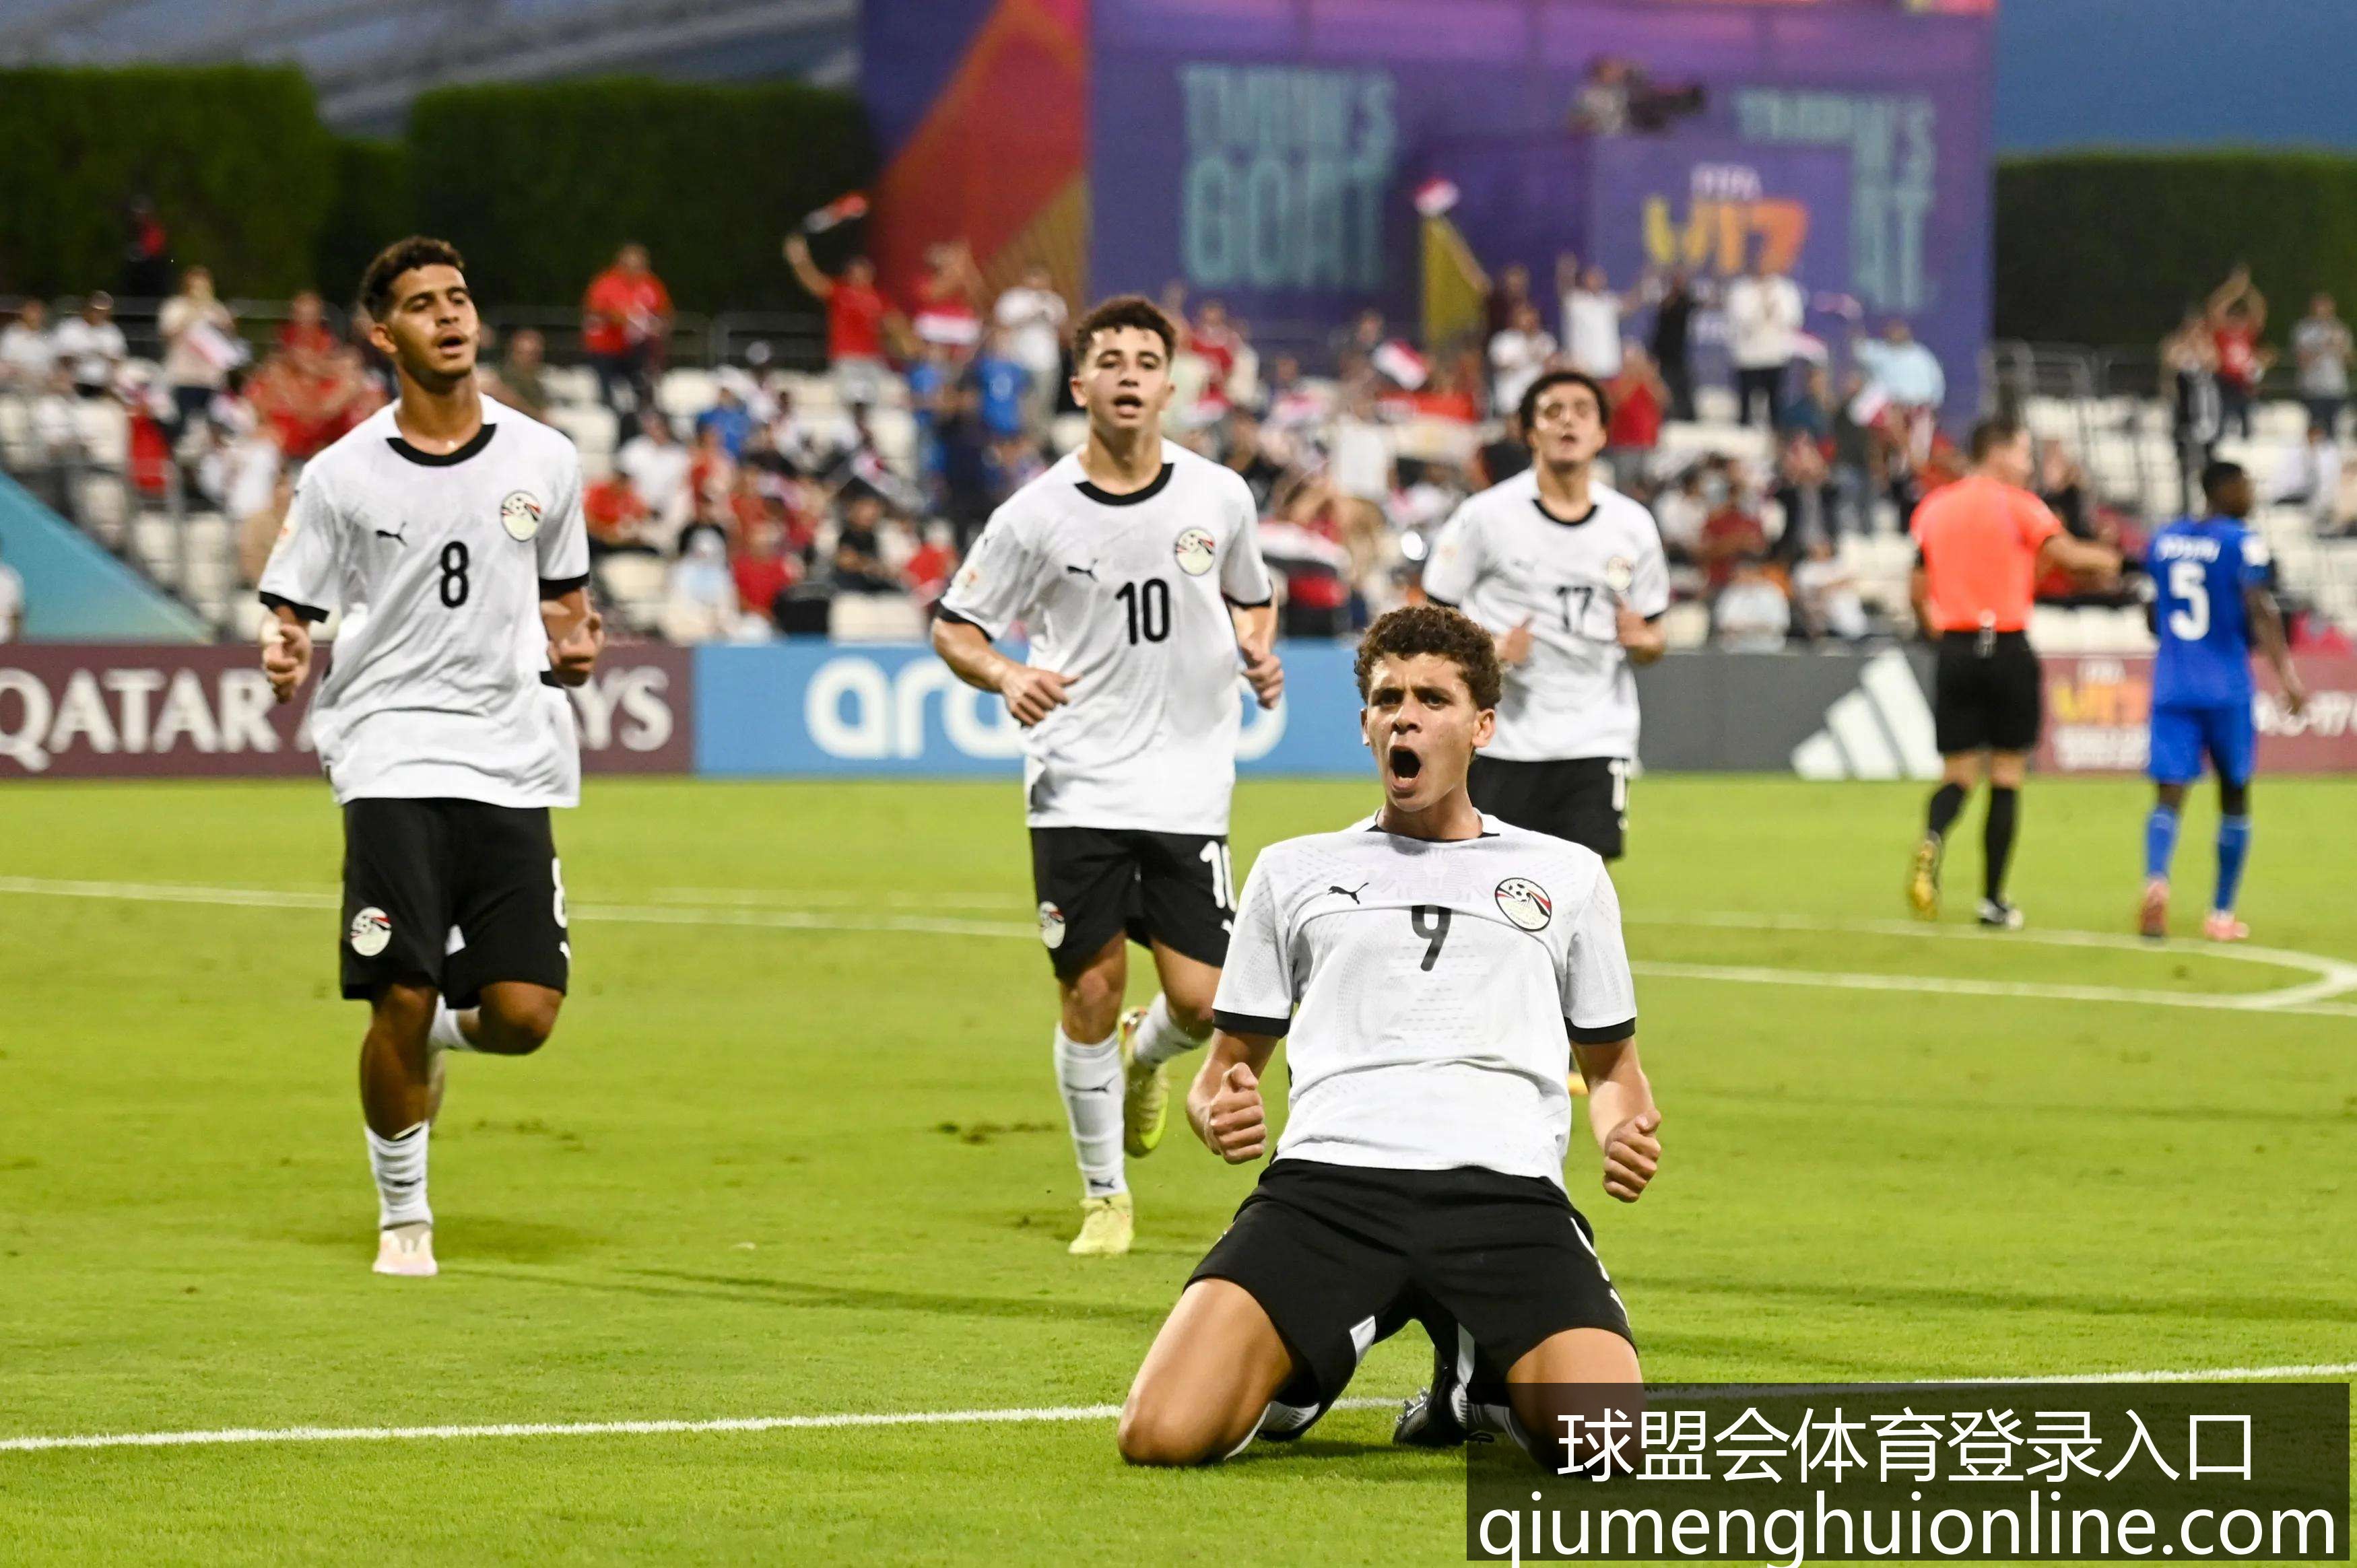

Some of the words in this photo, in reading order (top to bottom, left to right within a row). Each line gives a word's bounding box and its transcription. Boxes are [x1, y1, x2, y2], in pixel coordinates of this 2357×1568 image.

[438, 541, 469, 609] 8
[2168, 560, 2210, 640] 5
[1115, 578, 1171, 646] 10
[1556, 585, 1593, 634] 17
[0, 667, 279, 772] QATAR
[1411, 904, 1453, 972] 9
